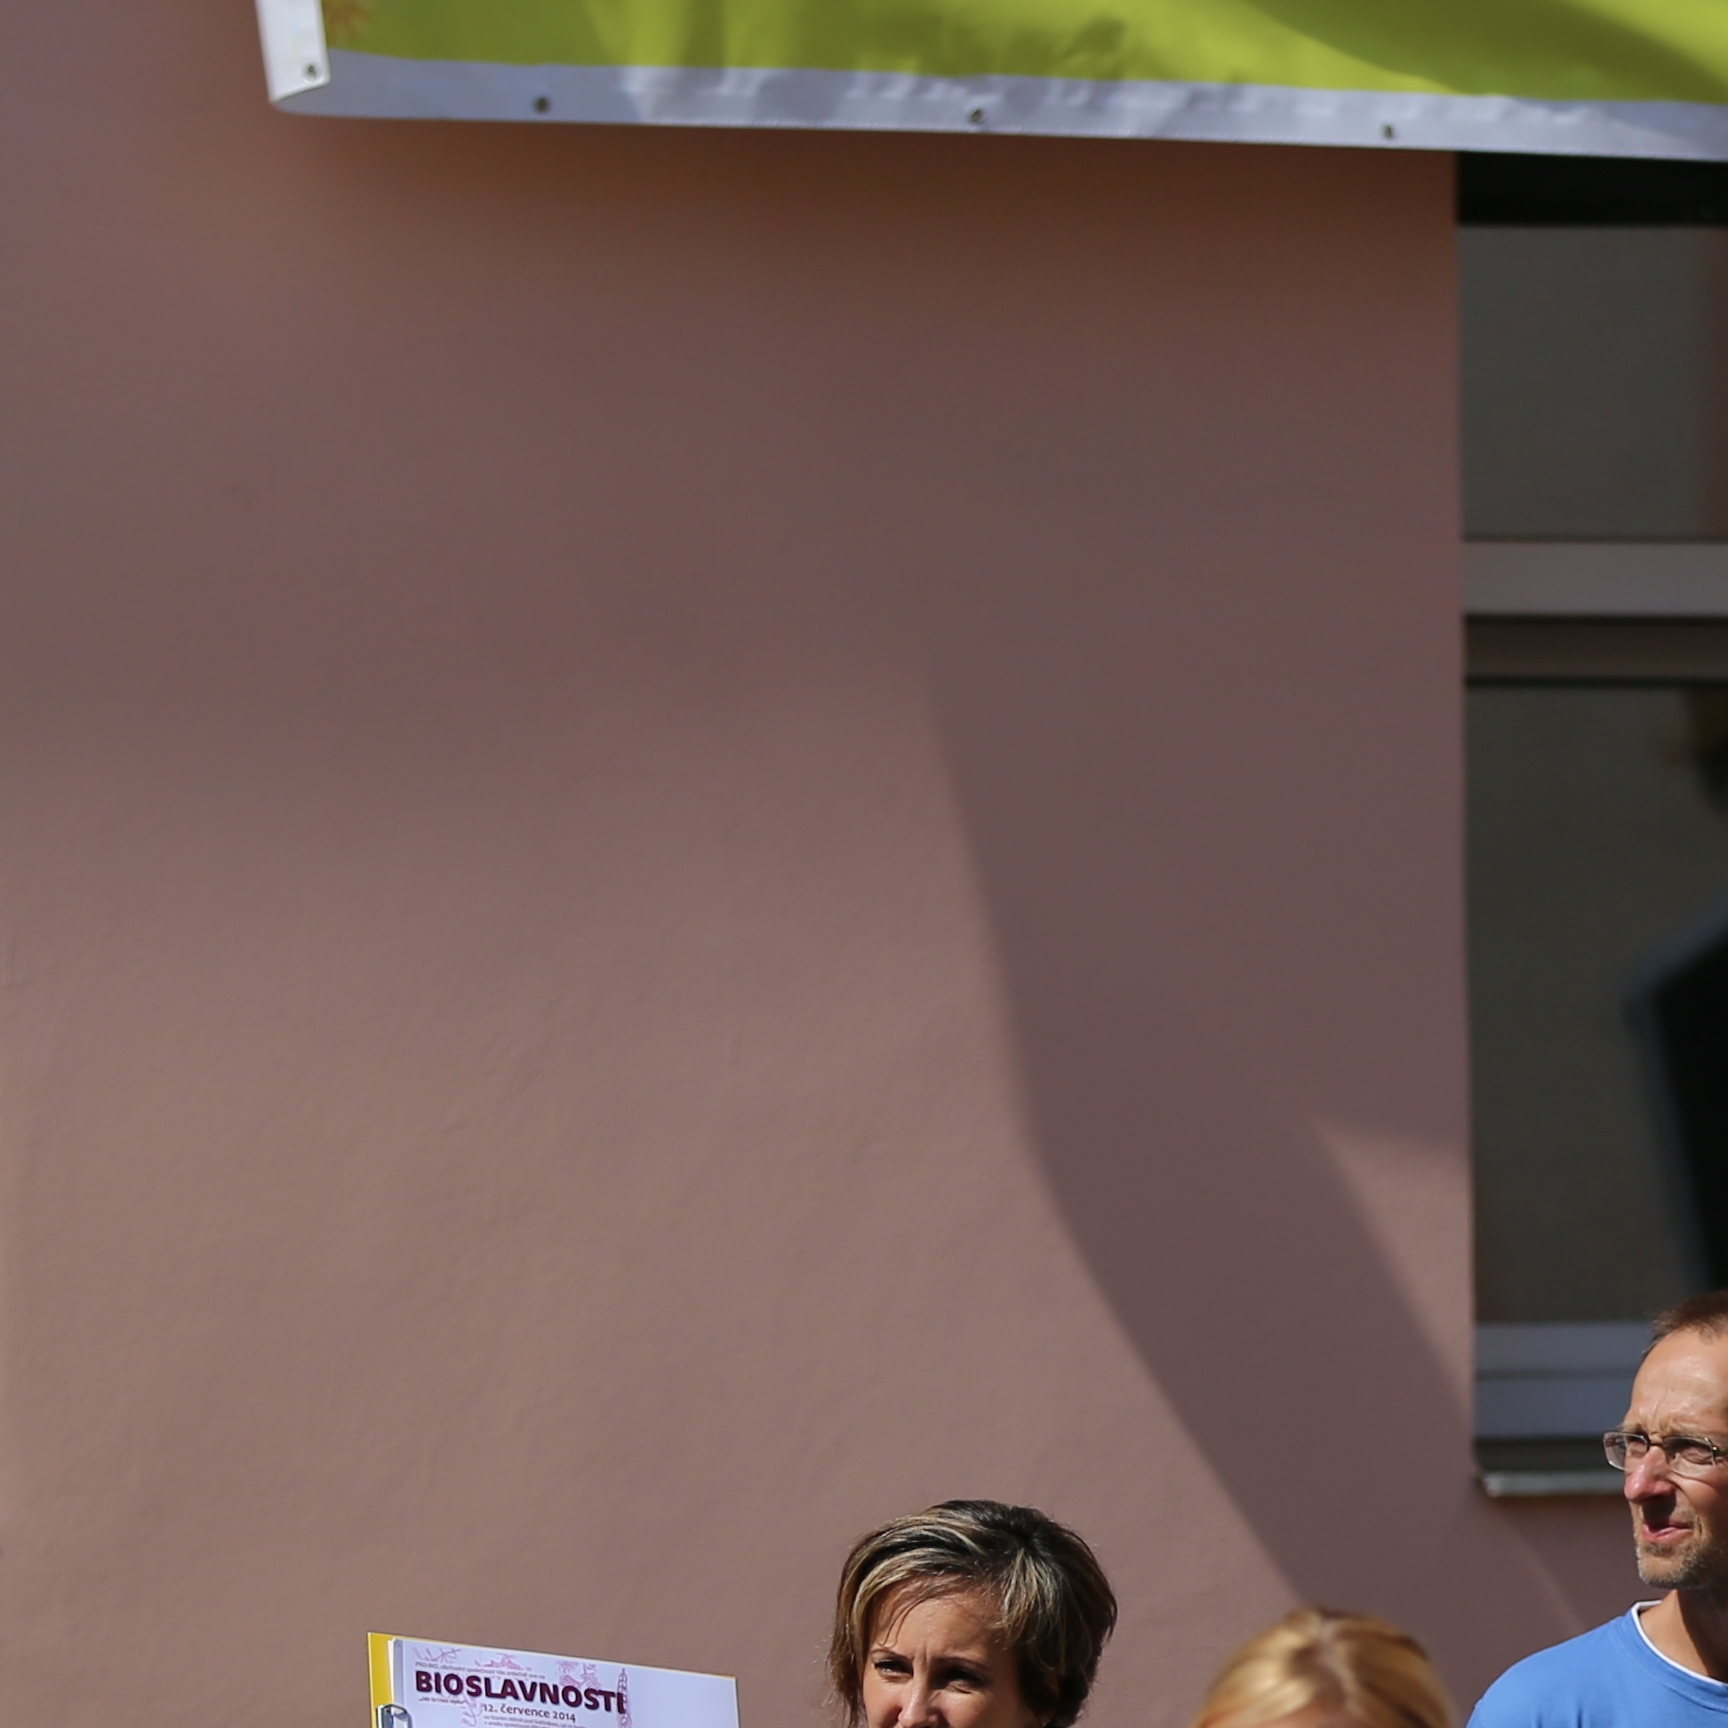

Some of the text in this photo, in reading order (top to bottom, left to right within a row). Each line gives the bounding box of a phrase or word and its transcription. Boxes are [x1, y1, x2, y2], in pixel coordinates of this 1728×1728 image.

[415, 1670, 627, 1715] BIOSLAVNOSTI
[483, 1703, 498, 1713] 12.
[501, 1703, 550, 1719] července
[553, 1710, 576, 1723] 2014
